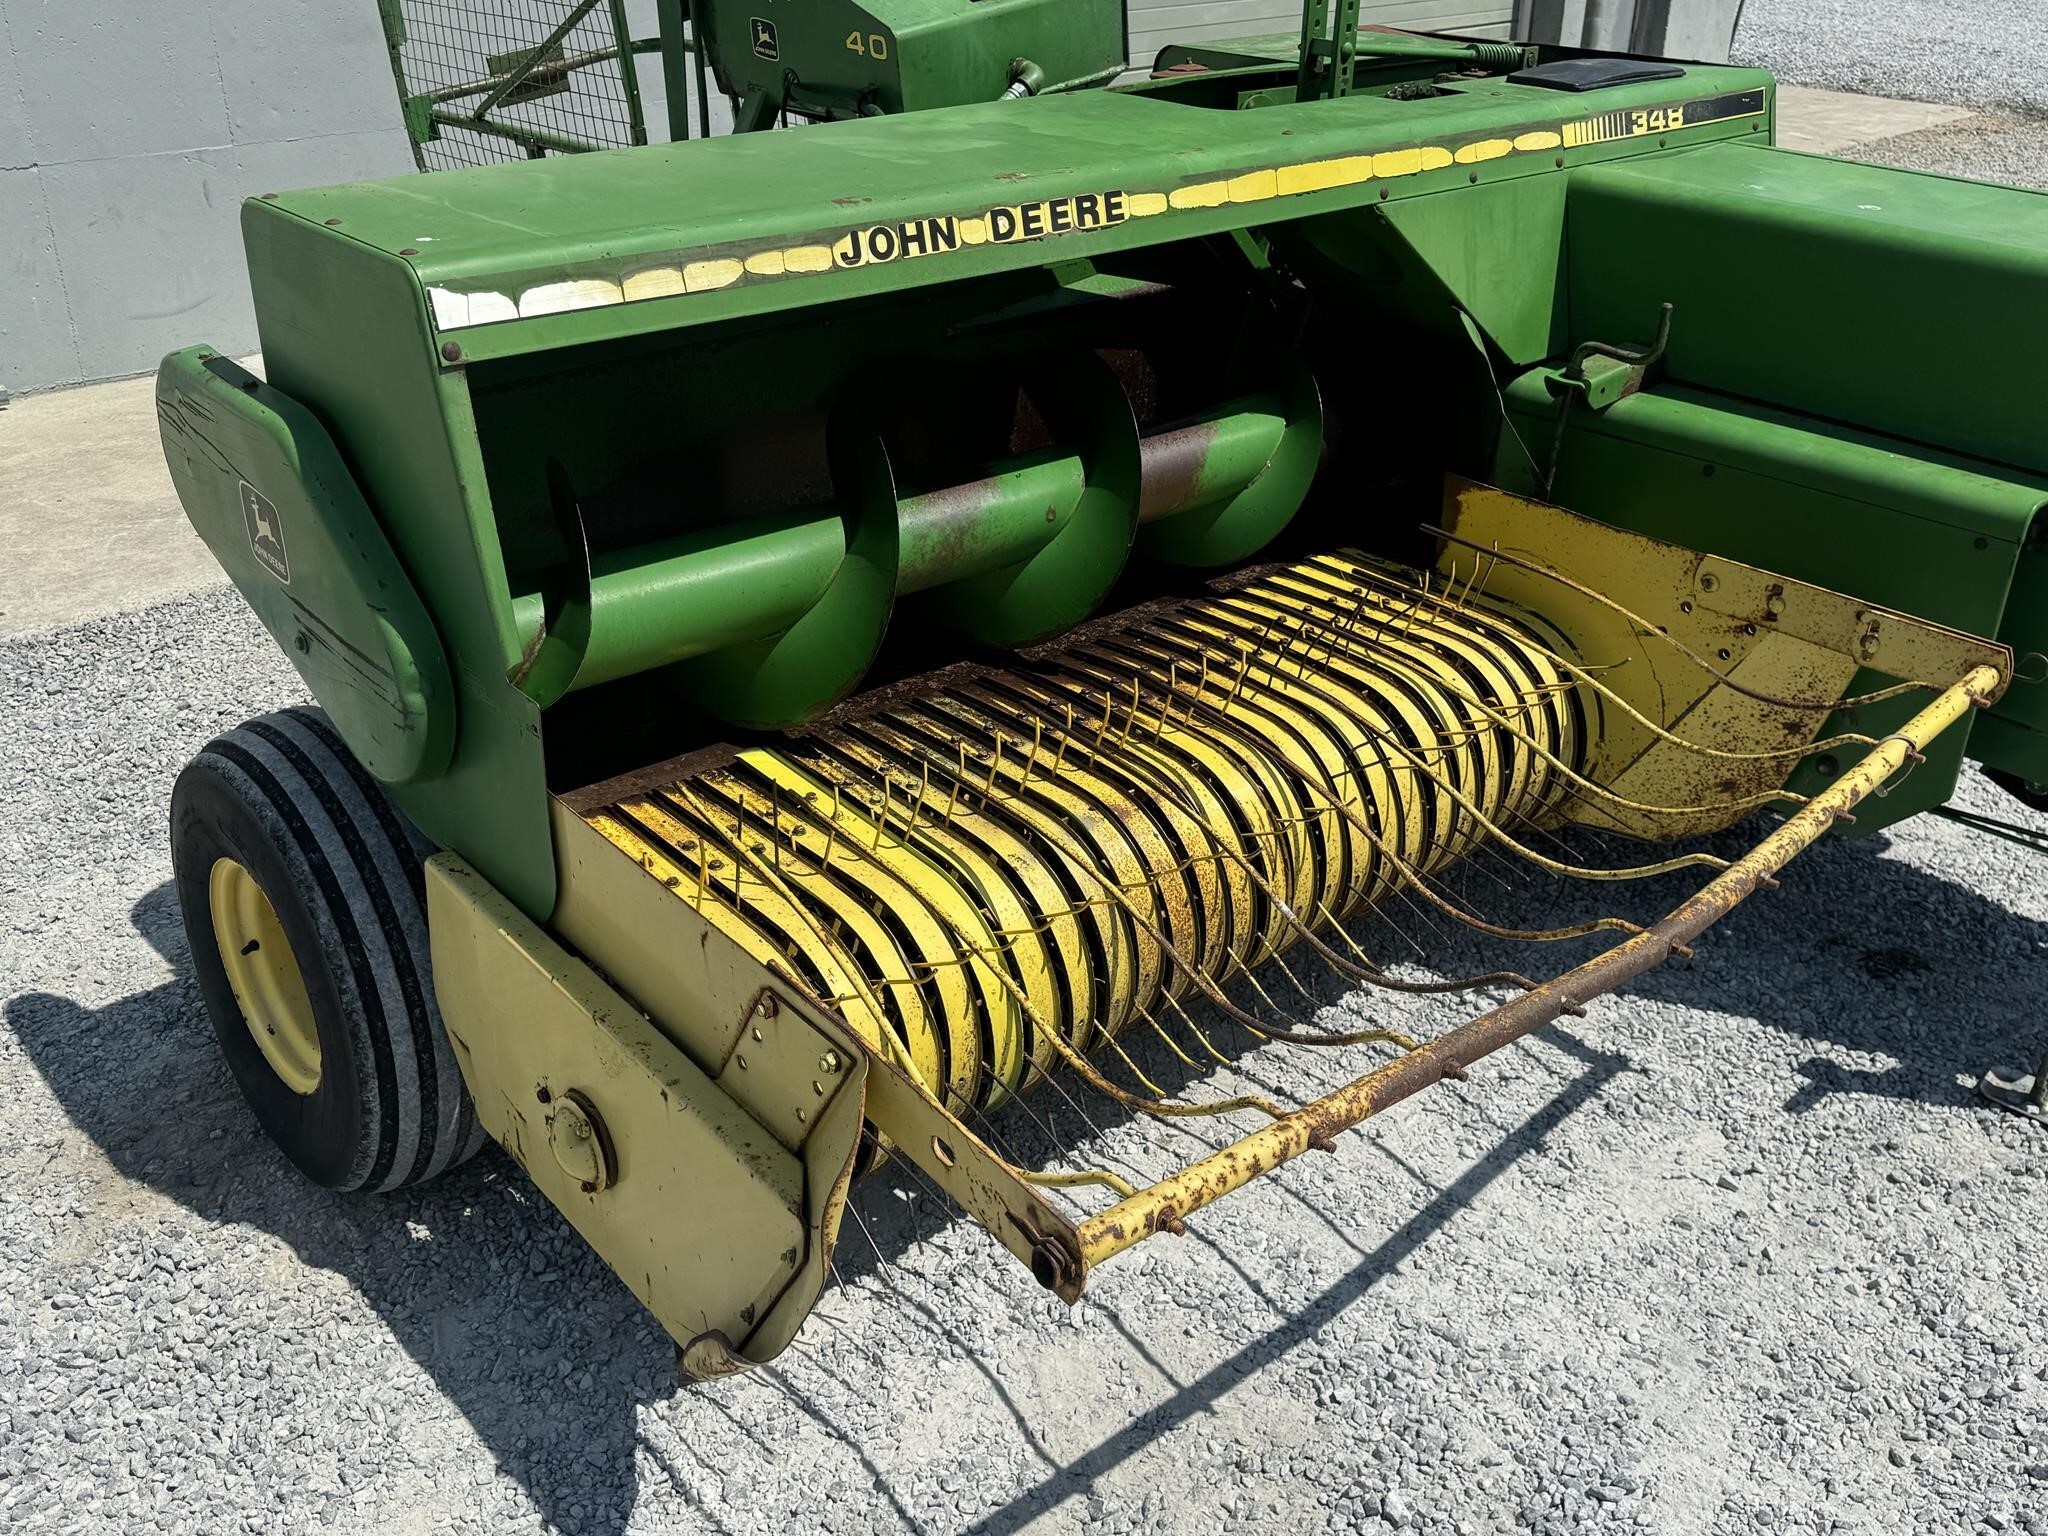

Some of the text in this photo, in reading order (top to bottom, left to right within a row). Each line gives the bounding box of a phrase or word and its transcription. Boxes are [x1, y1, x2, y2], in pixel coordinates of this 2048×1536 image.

[846, 31, 887, 60] 40
[1631, 107, 1684, 134] 348
[840, 190, 1126, 263] JOHN DEERE
